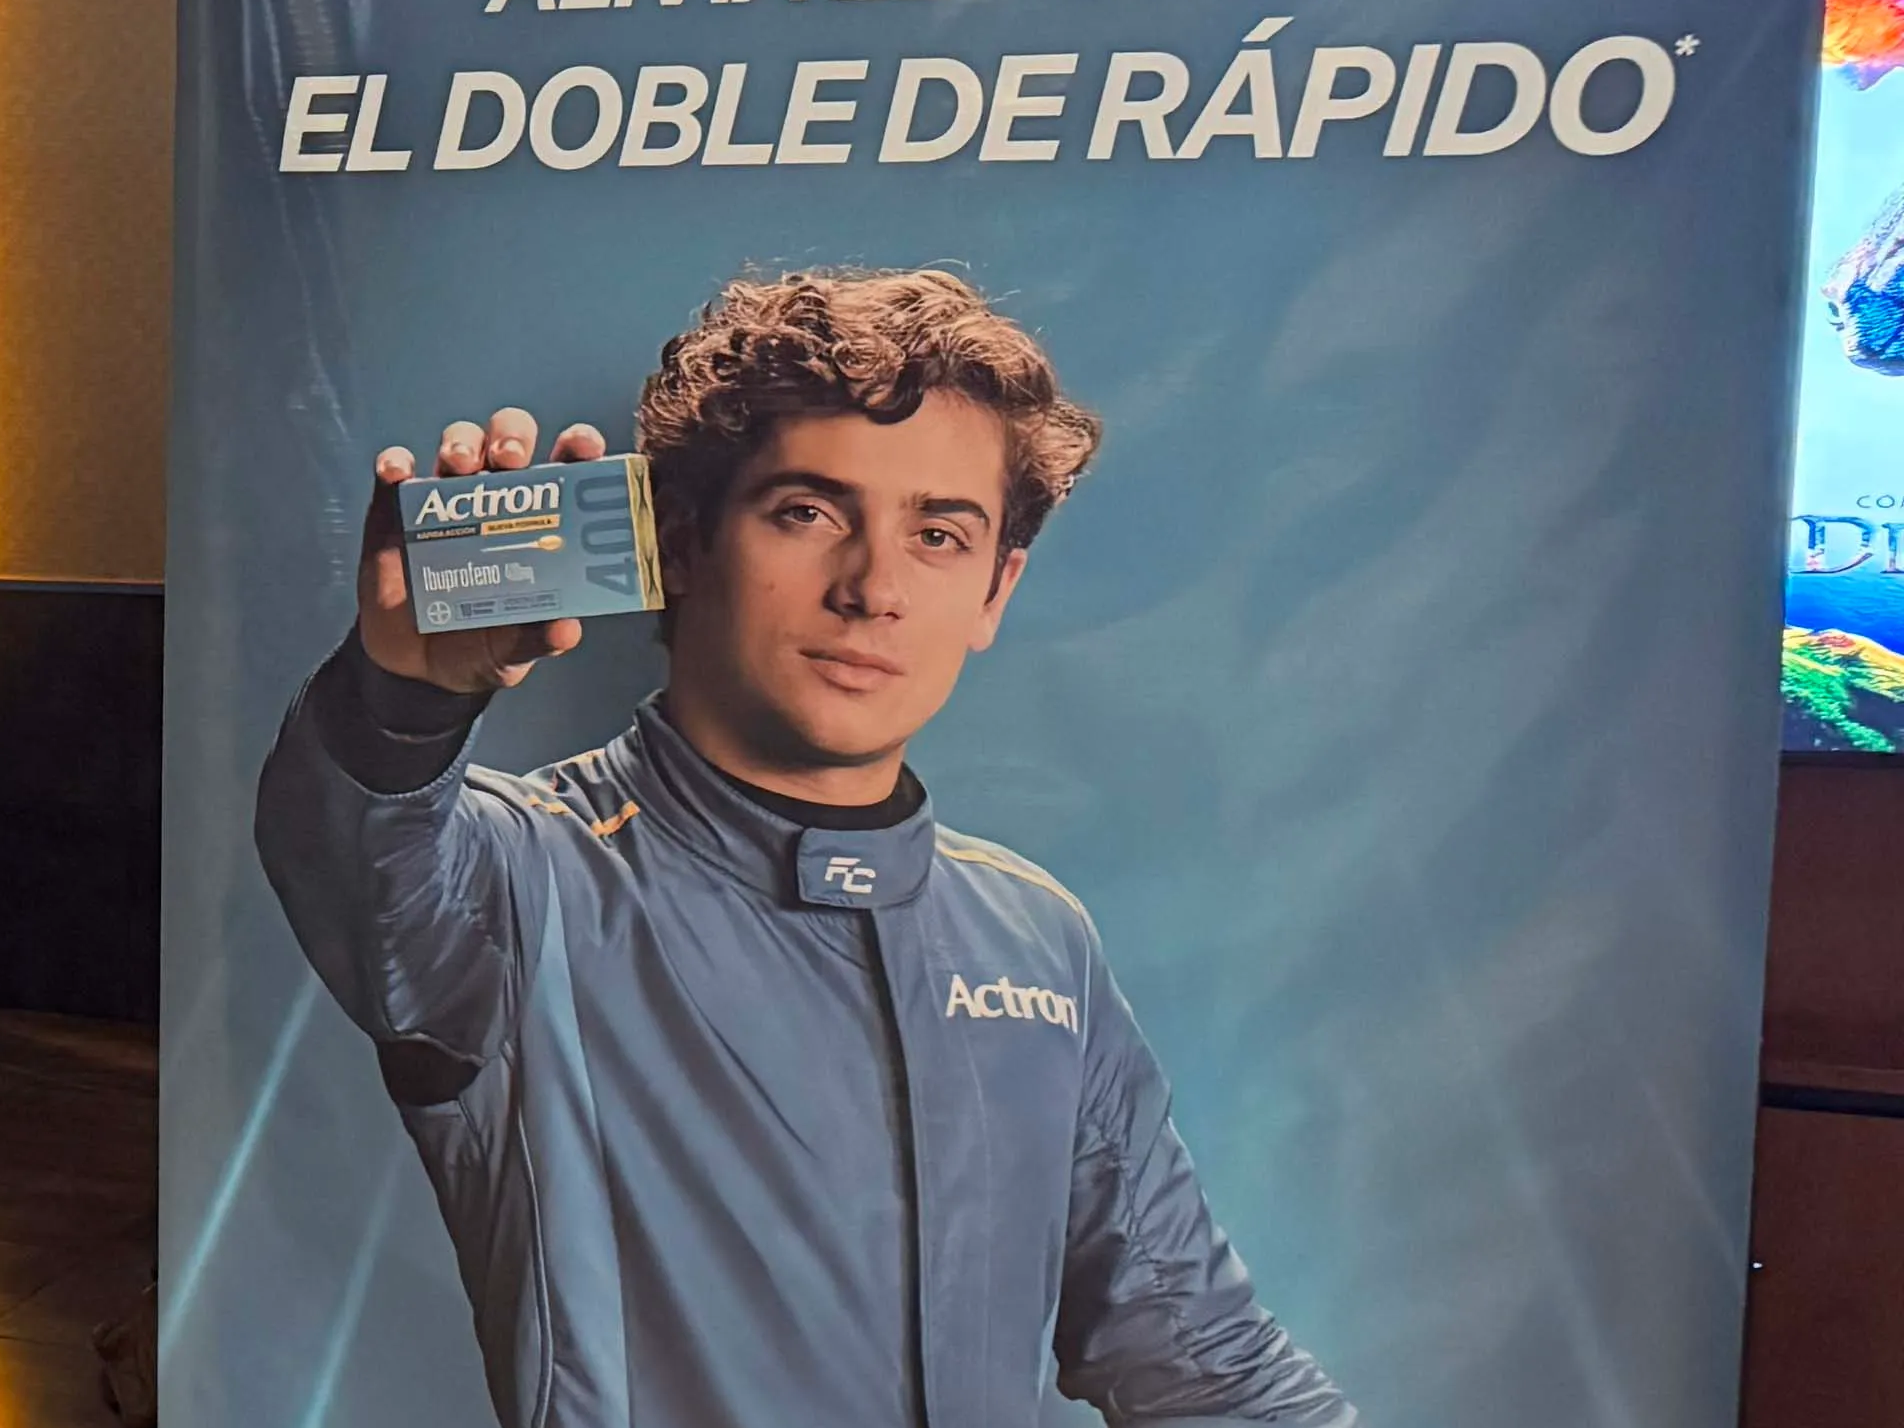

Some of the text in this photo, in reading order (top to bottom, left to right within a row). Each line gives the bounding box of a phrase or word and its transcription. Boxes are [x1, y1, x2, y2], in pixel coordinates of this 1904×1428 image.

[279, 73, 413, 172] EL
[433, 60, 869, 171] DOBLE
[878, 52, 1079, 163] DE
[1856, 494, 1904, 509] CO
[423, 562, 501, 593] Ibuprofeno
[825, 857, 876, 894] FC
[946, 974, 1078, 1035] Actron
